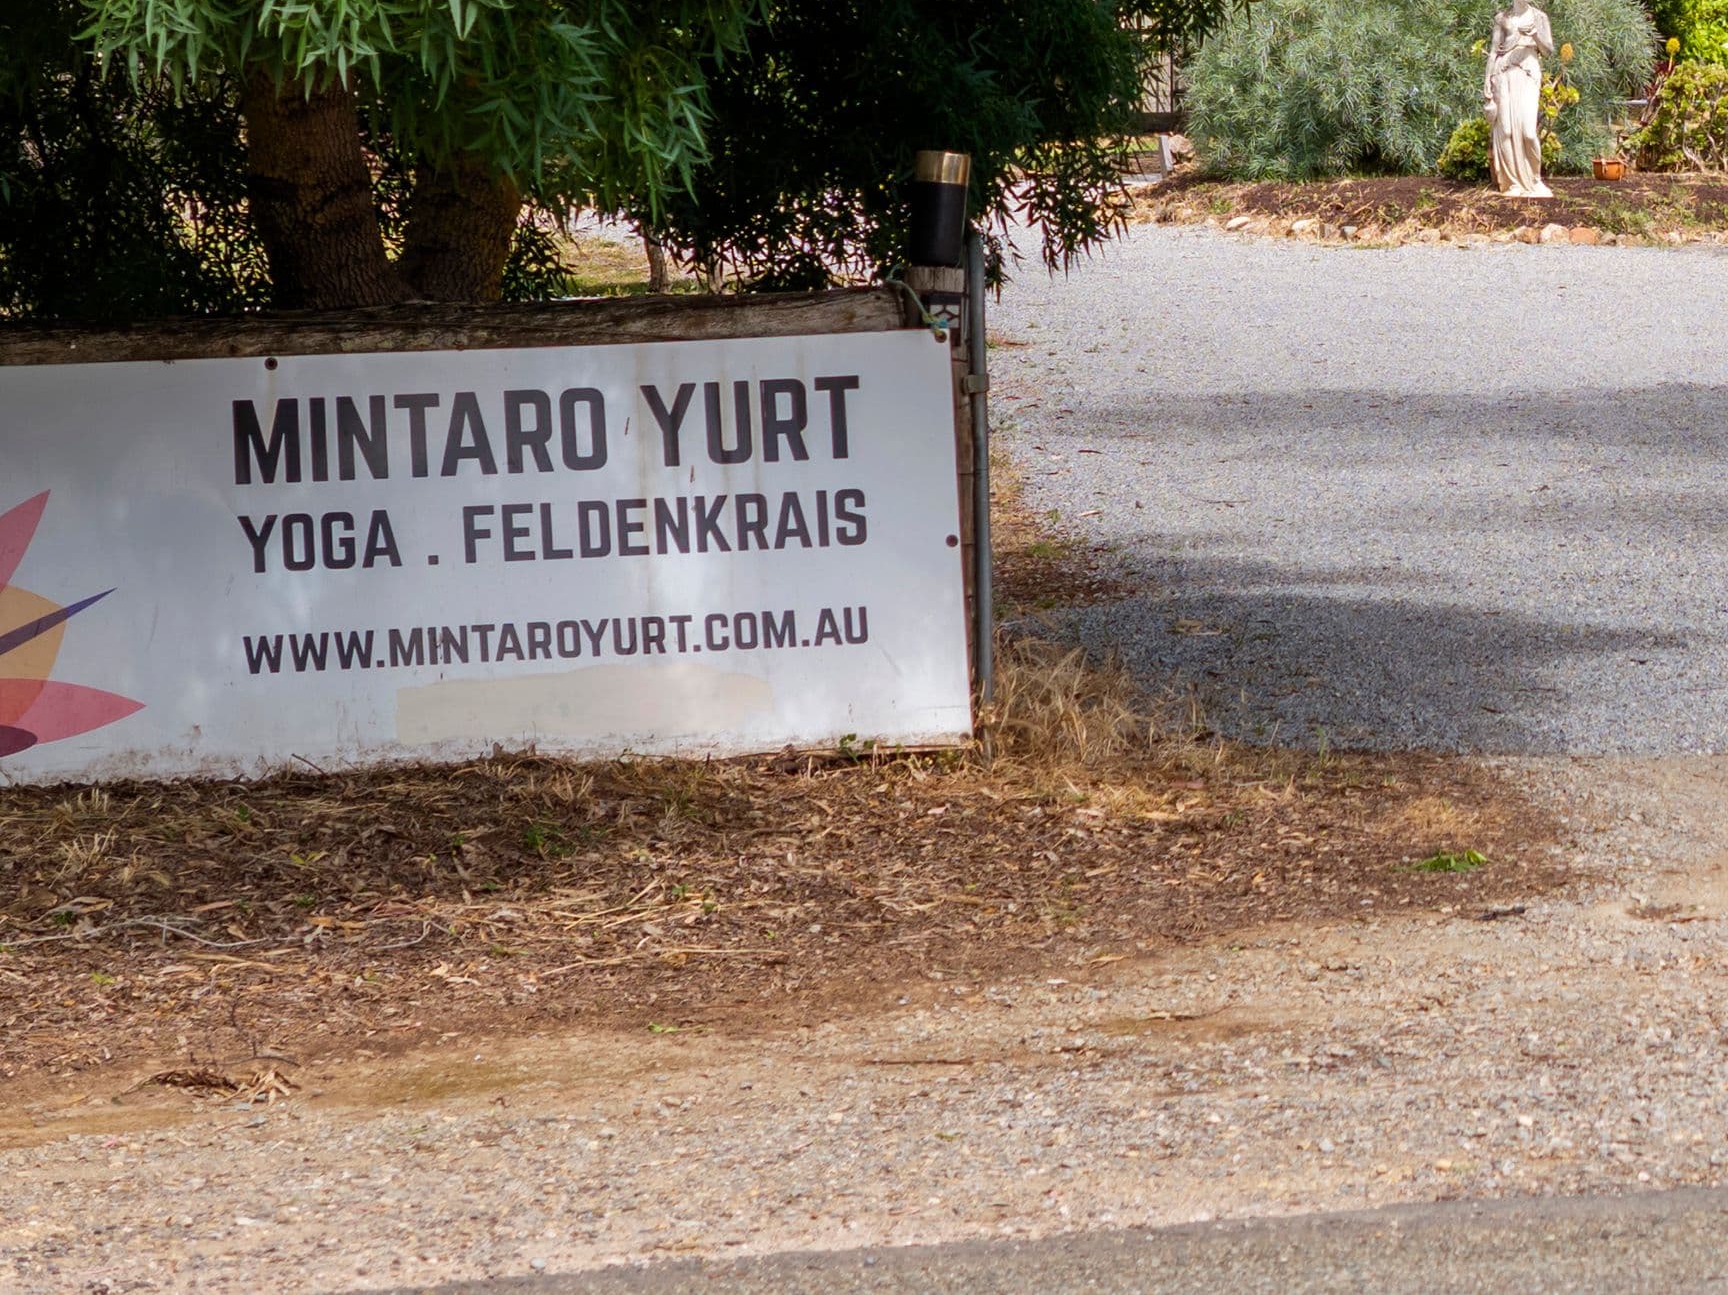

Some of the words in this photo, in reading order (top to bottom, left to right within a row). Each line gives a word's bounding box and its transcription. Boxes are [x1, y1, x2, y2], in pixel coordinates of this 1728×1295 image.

[231, 387, 608, 486] MINTARO
[639, 374, 860, 467] YURT
[236, 509, 403, 574] YOGA
[462, 488, 867, 564] FELDENKRAIS
[242, 606, 868, 675] WWW.MINTAROYURT.COM.AU
